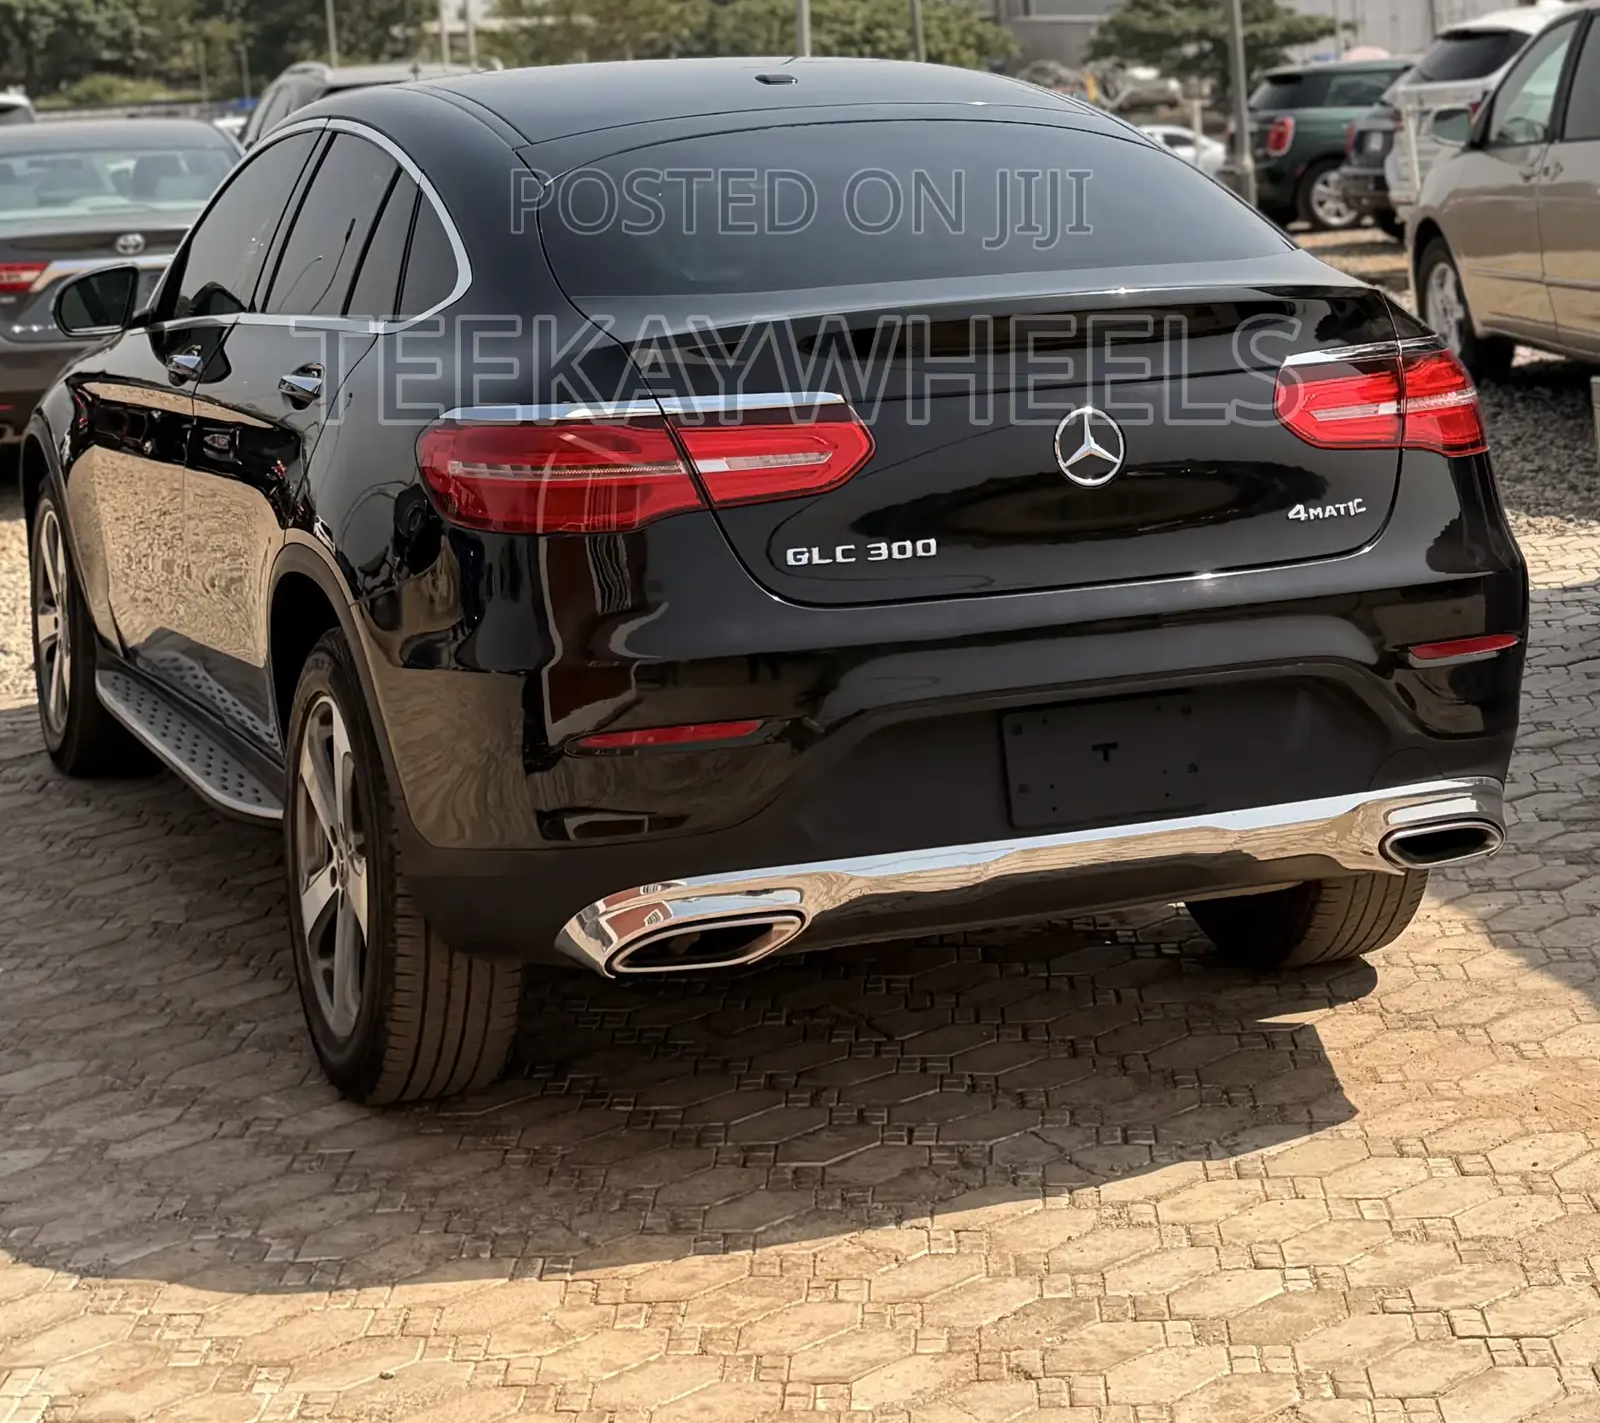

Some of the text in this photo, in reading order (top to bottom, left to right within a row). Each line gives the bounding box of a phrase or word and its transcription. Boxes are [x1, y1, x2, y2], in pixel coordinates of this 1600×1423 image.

[1287, 498, 1367, 521] 4MATIC
[786, 538, 937, 566] GLC 300
